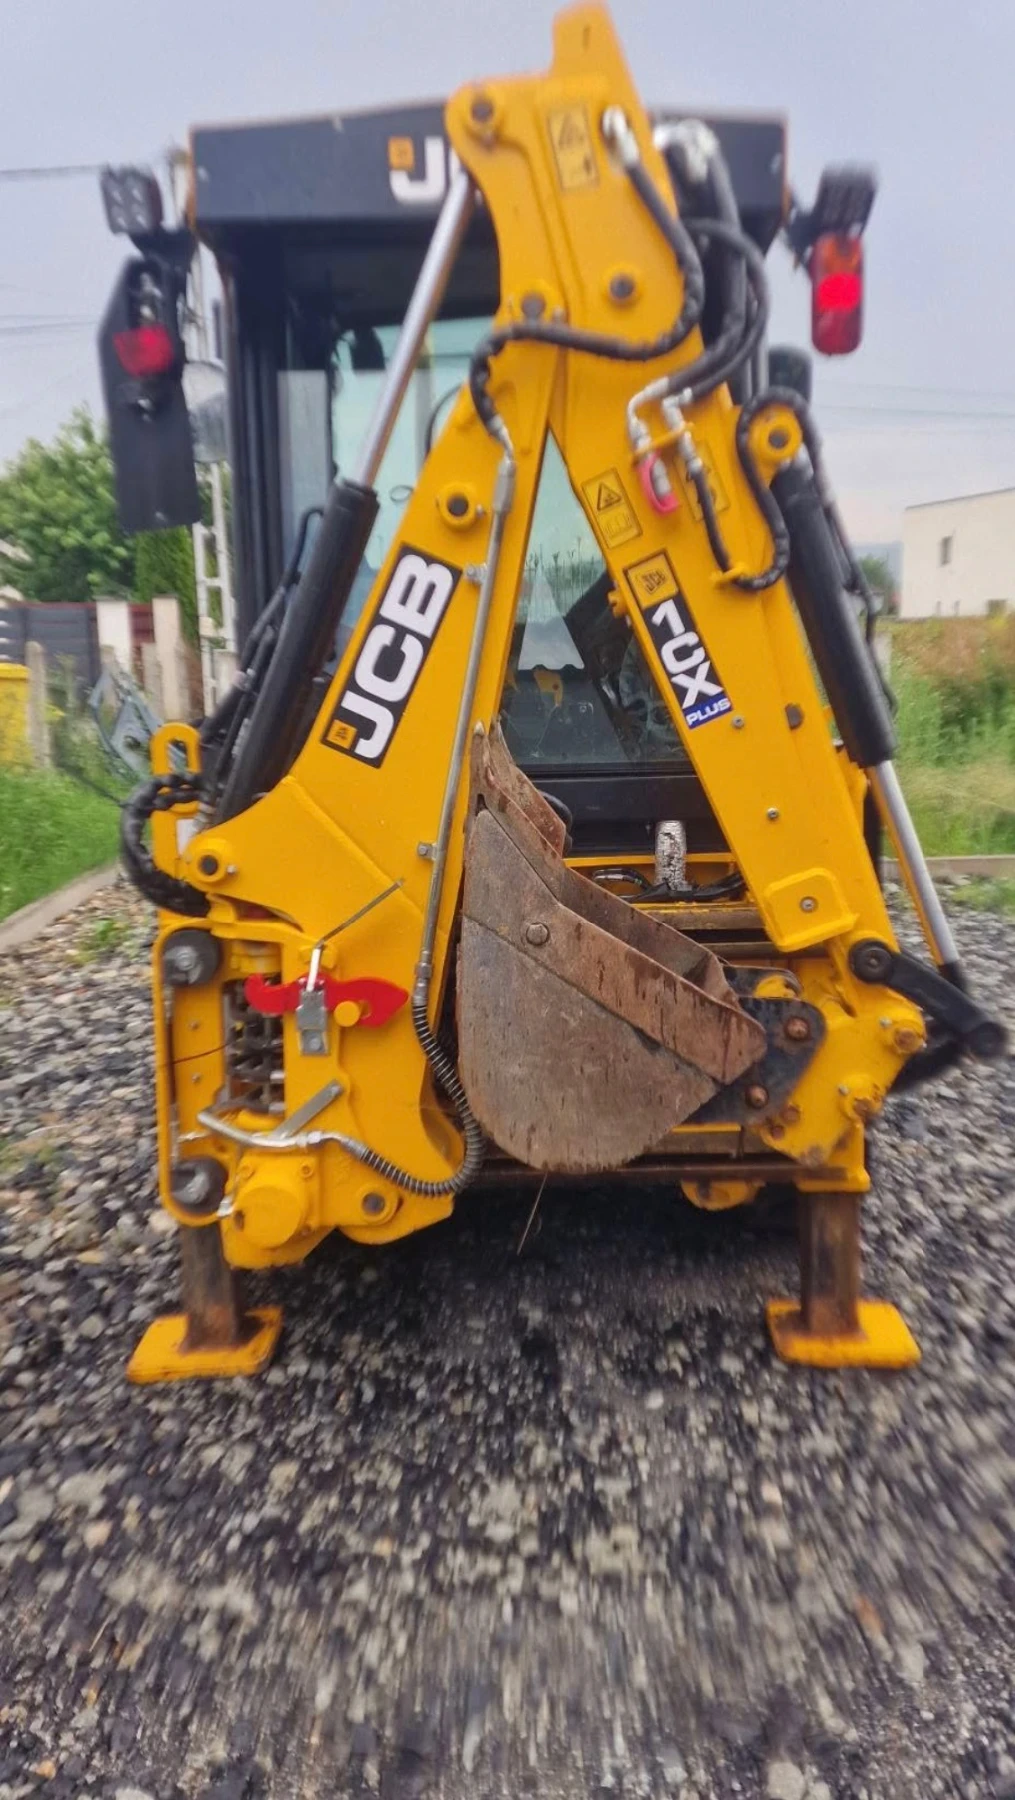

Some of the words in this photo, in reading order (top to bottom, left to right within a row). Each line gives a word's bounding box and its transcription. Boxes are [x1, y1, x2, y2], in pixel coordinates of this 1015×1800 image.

[389, 136, 460, 204] J
[341, 554, 454, 759] JCB
[651, 598, 724, 709] 1CX
[685, 698, 732, 726] PLUS
